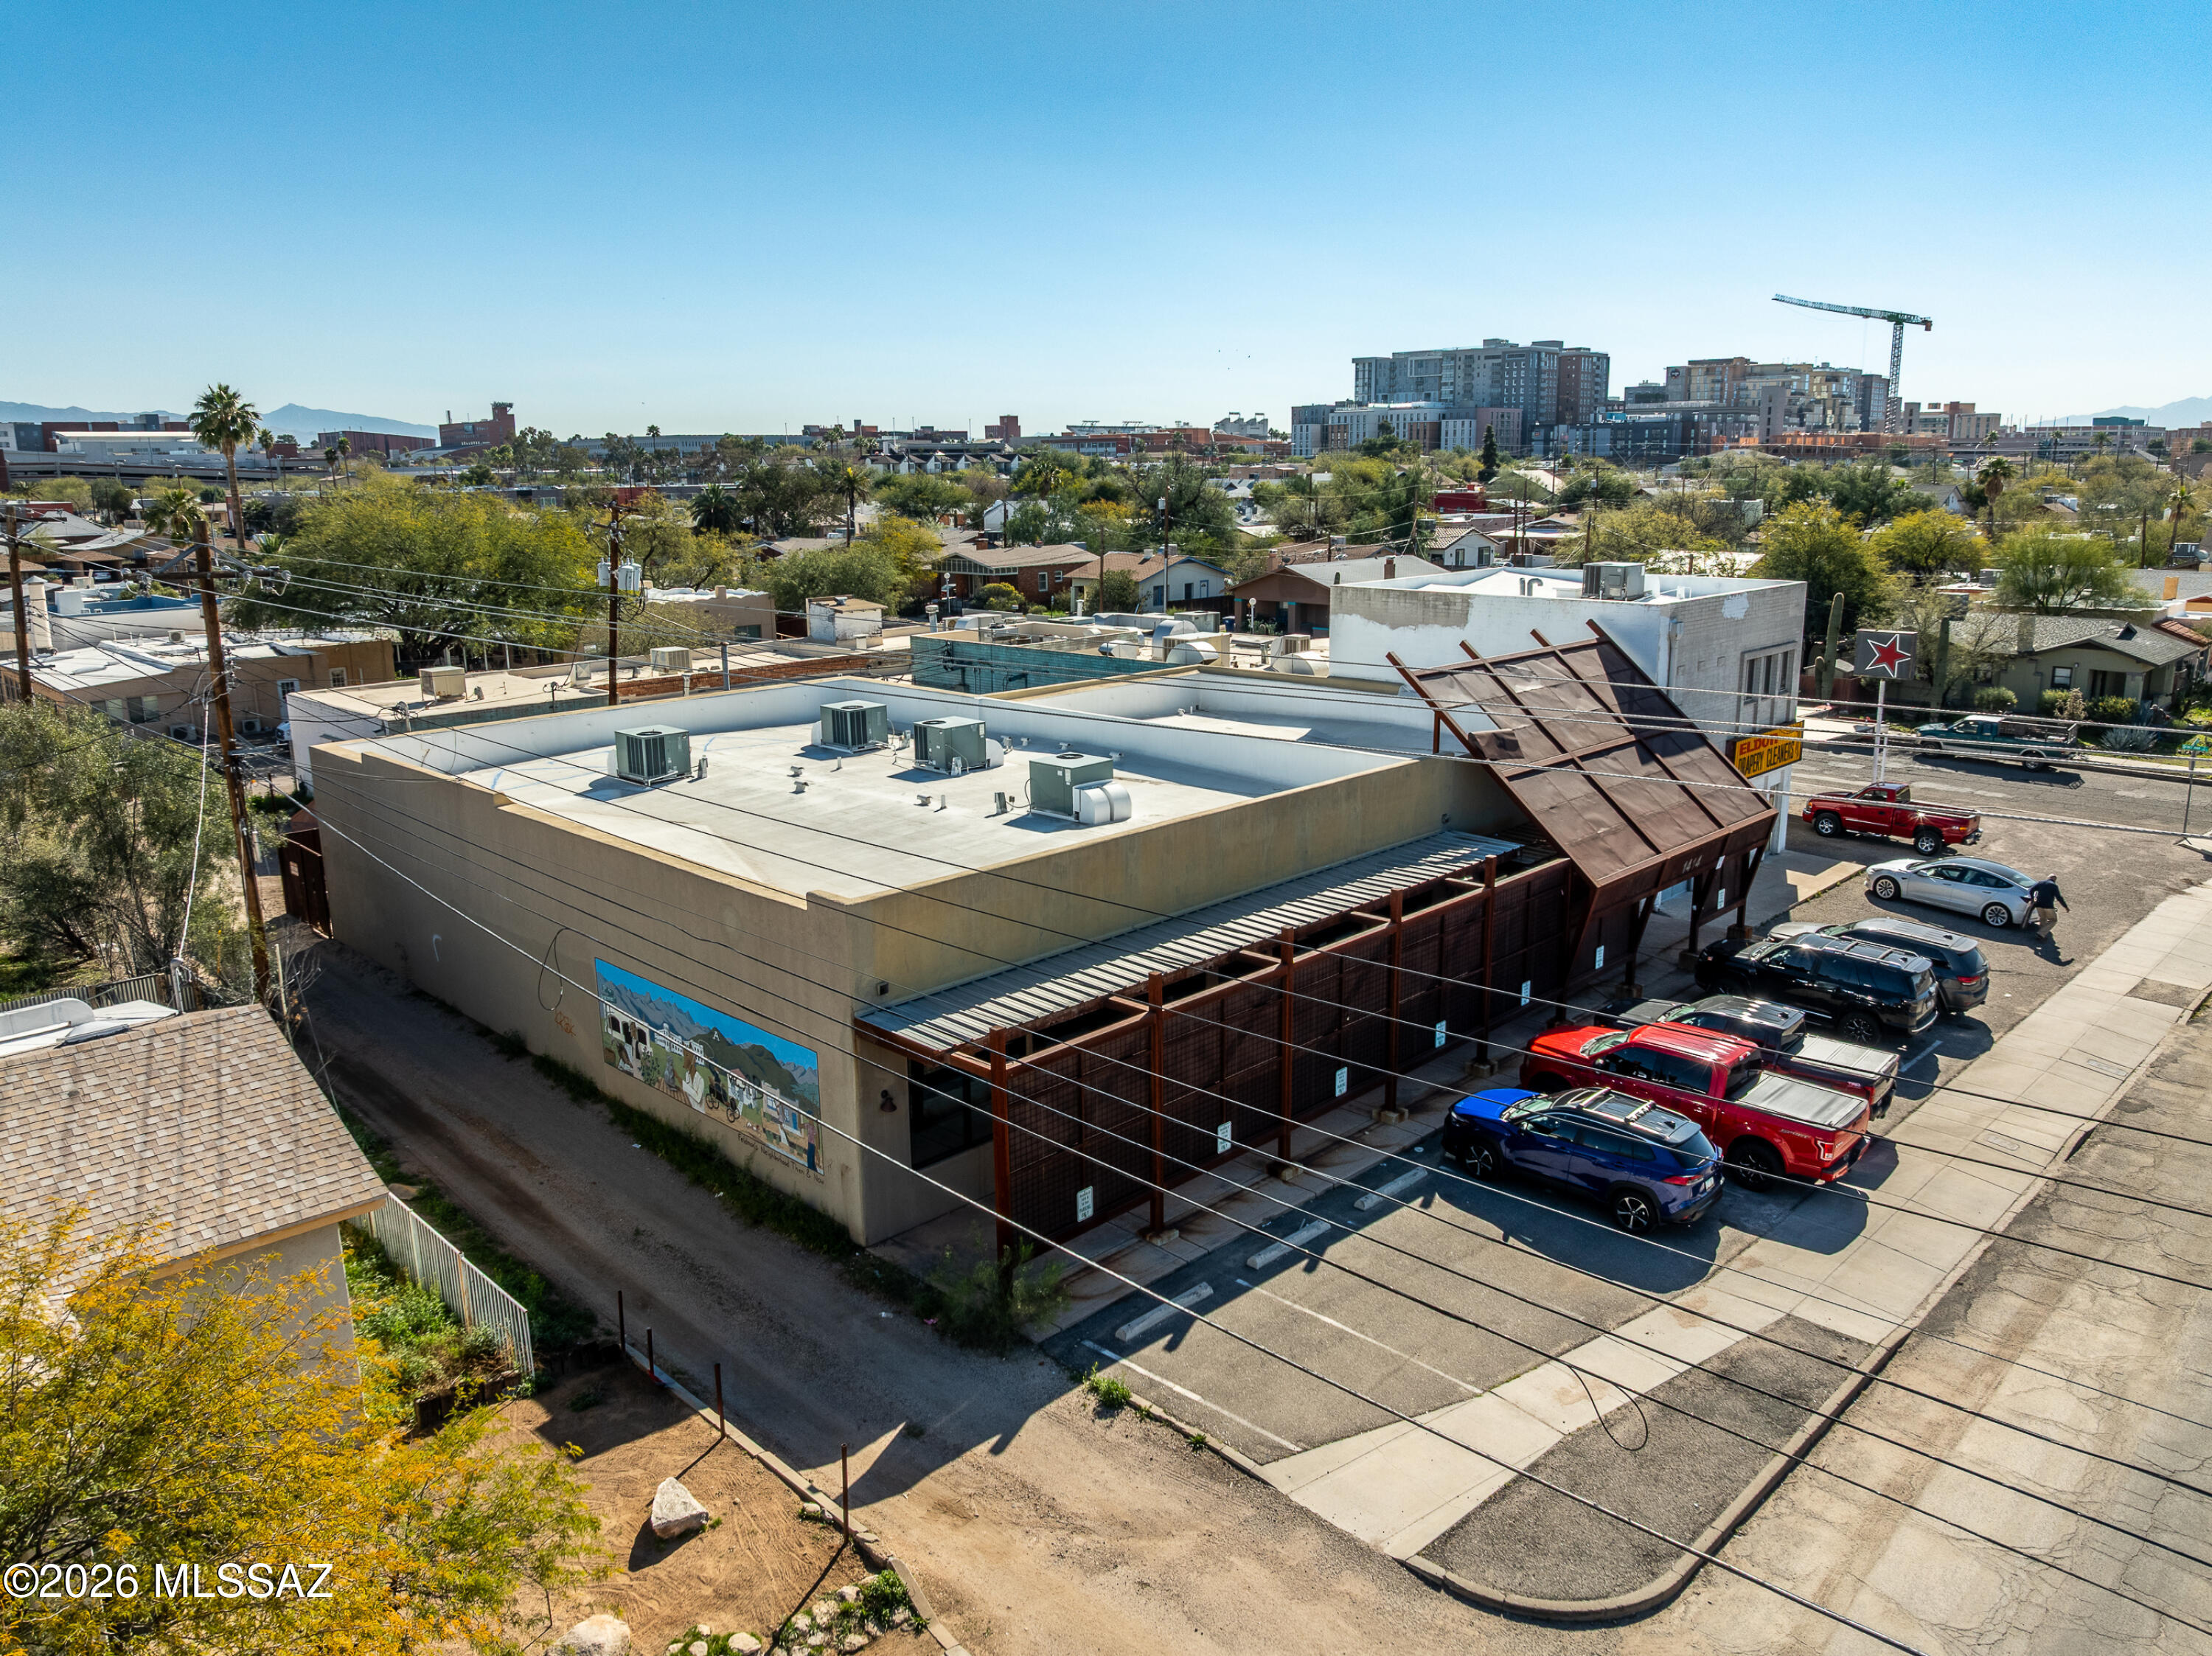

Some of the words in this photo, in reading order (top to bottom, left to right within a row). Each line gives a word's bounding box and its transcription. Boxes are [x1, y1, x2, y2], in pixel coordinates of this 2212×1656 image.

[1738, 751, 1764, 776] DRAPERY
[1767, 740, 1795, 768] CLEANERS
[1682, 855, 1703, 874] 1414
[790, 1161, 804, 1175] Then
[806, 1169, 811, 1178] &
